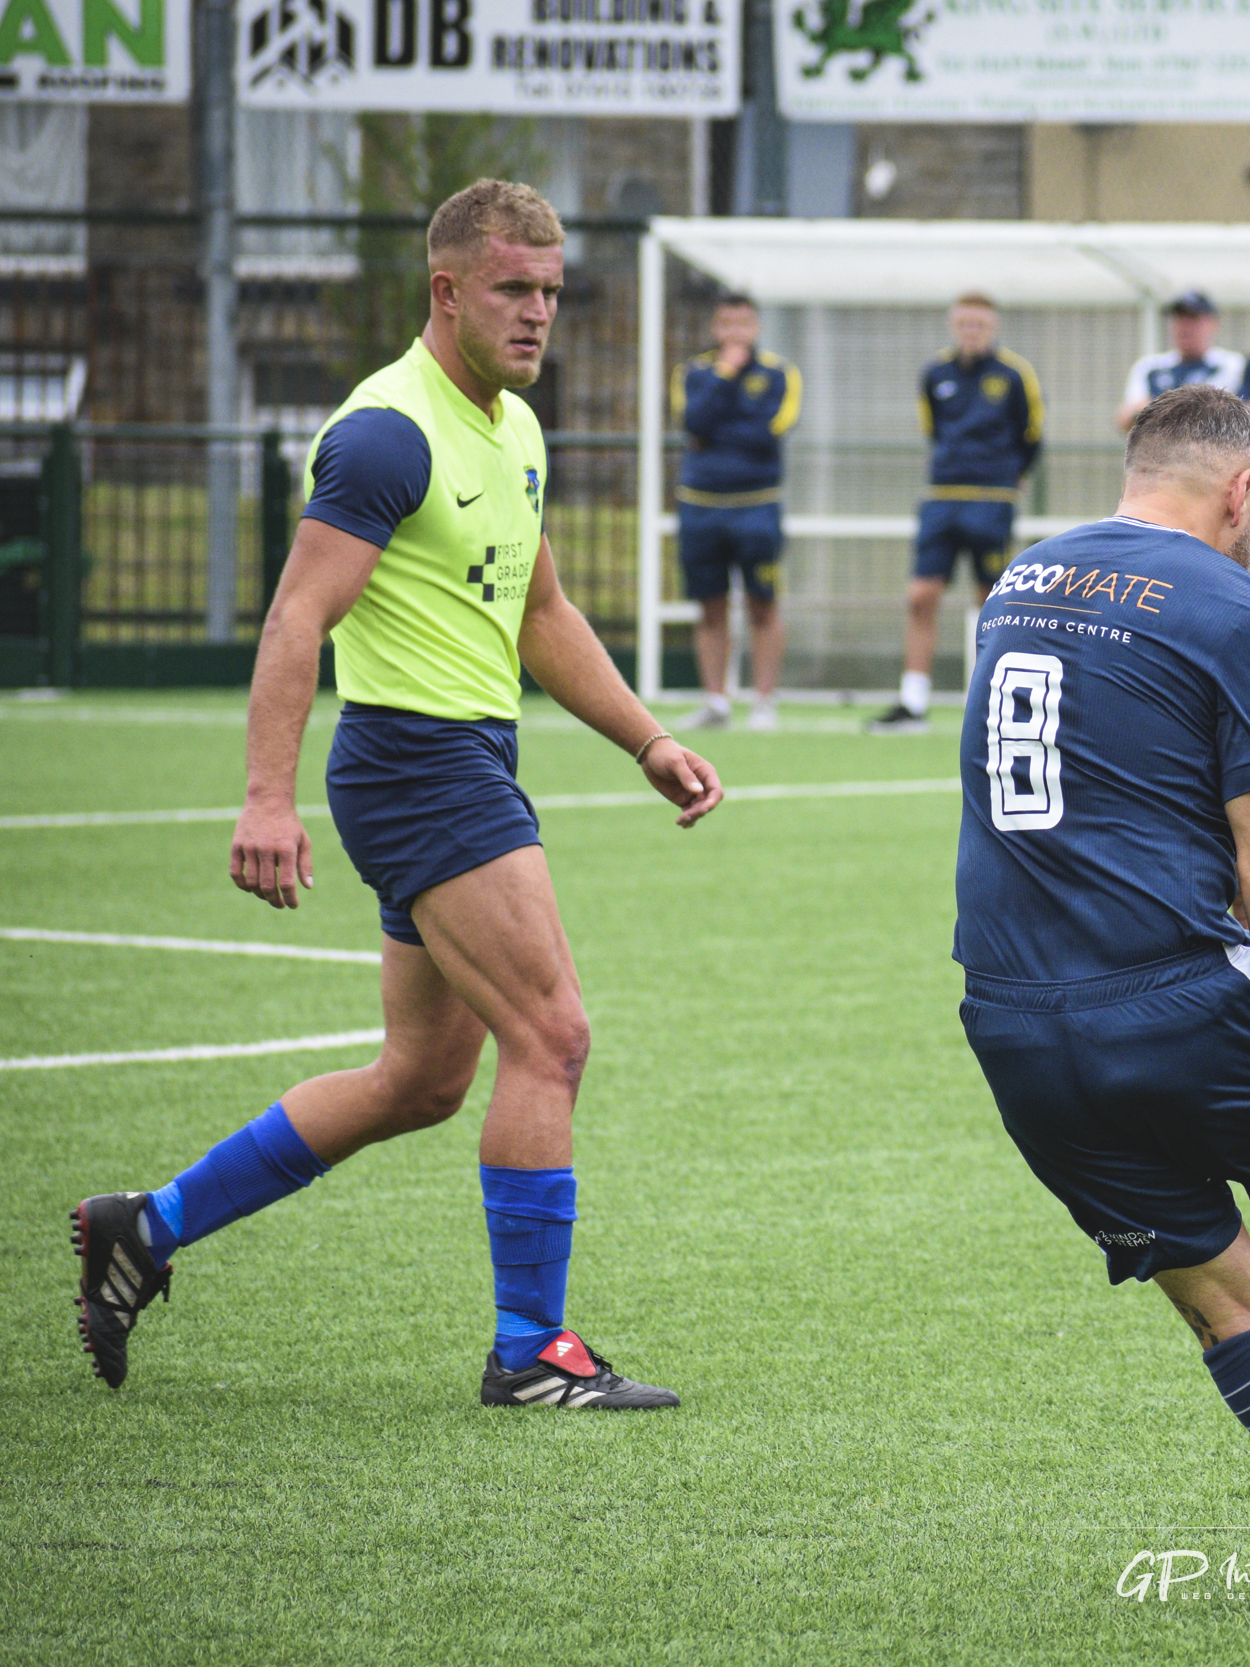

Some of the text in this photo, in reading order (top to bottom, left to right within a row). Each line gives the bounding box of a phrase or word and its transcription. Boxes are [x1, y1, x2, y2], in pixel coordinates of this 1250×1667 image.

[372, 0, 474, 69] DB
[491, 36, 719, 71] RENOVATIONS
[496, 542, 522, 560] FIRST
[496, 562, 530, 581] GRADE
[986, 563, 1174, 613] DECOMATE
[981, 615, 1132, 643] DECORATING CENTRE
[986, 651, 1064, 832] 8
